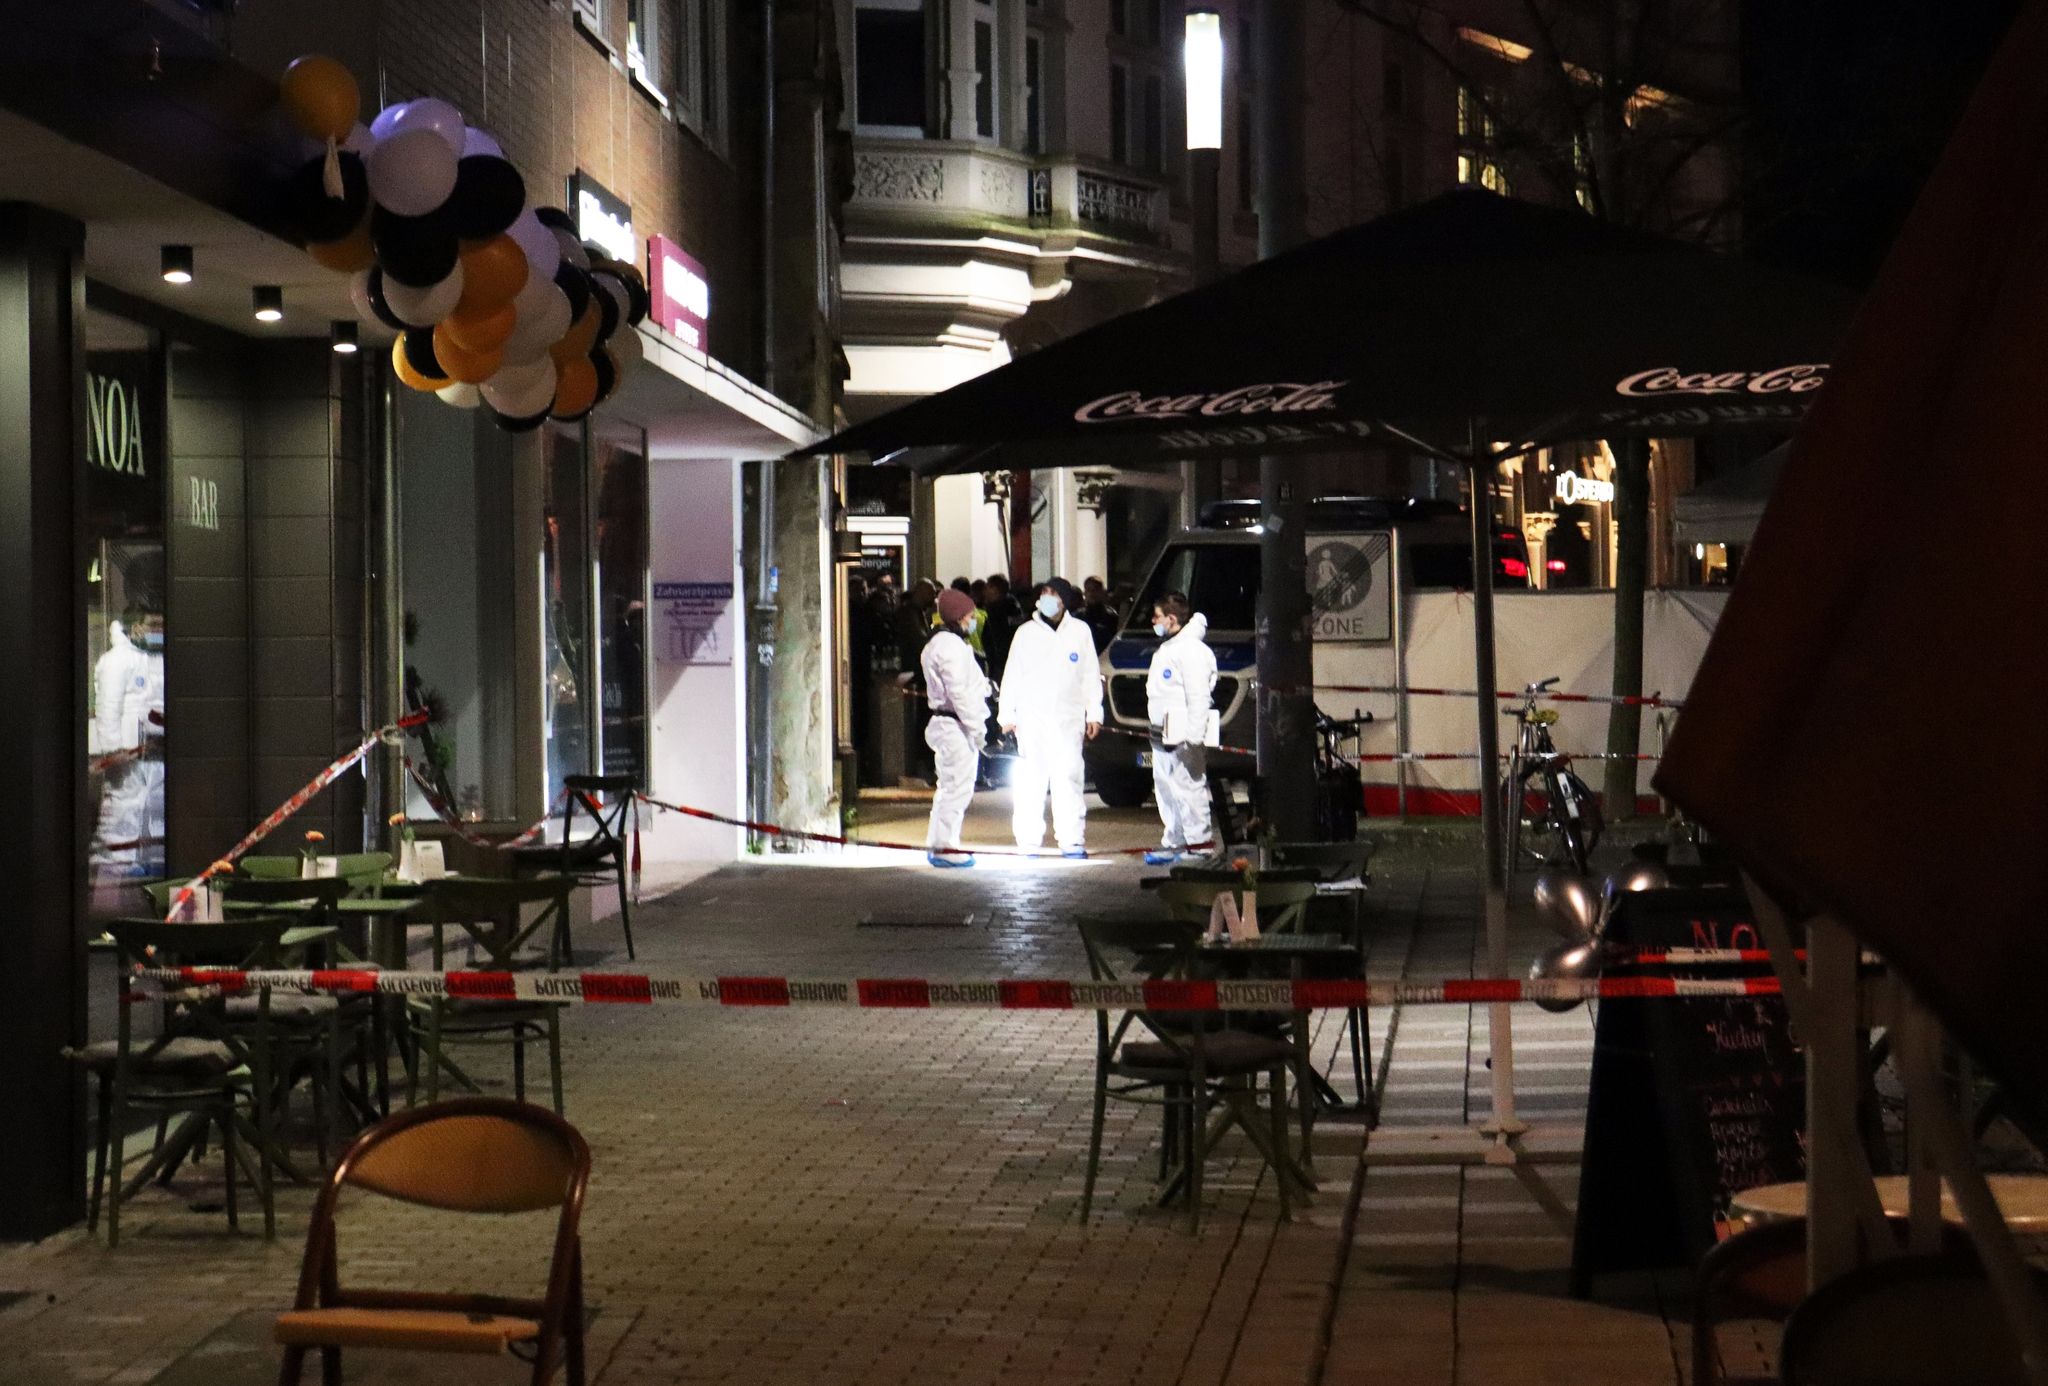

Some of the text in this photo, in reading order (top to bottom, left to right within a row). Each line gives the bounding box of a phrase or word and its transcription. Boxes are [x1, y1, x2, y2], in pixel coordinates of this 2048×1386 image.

[1074, 379, 1351, 424] Coca-Cola
[1616, 364, 1831, 397] Coca-Co
[86, 371, 145, 477] NOA
[190, 476, 218, 531] BAR
[1312, 617, 1364, 635] ZONE
